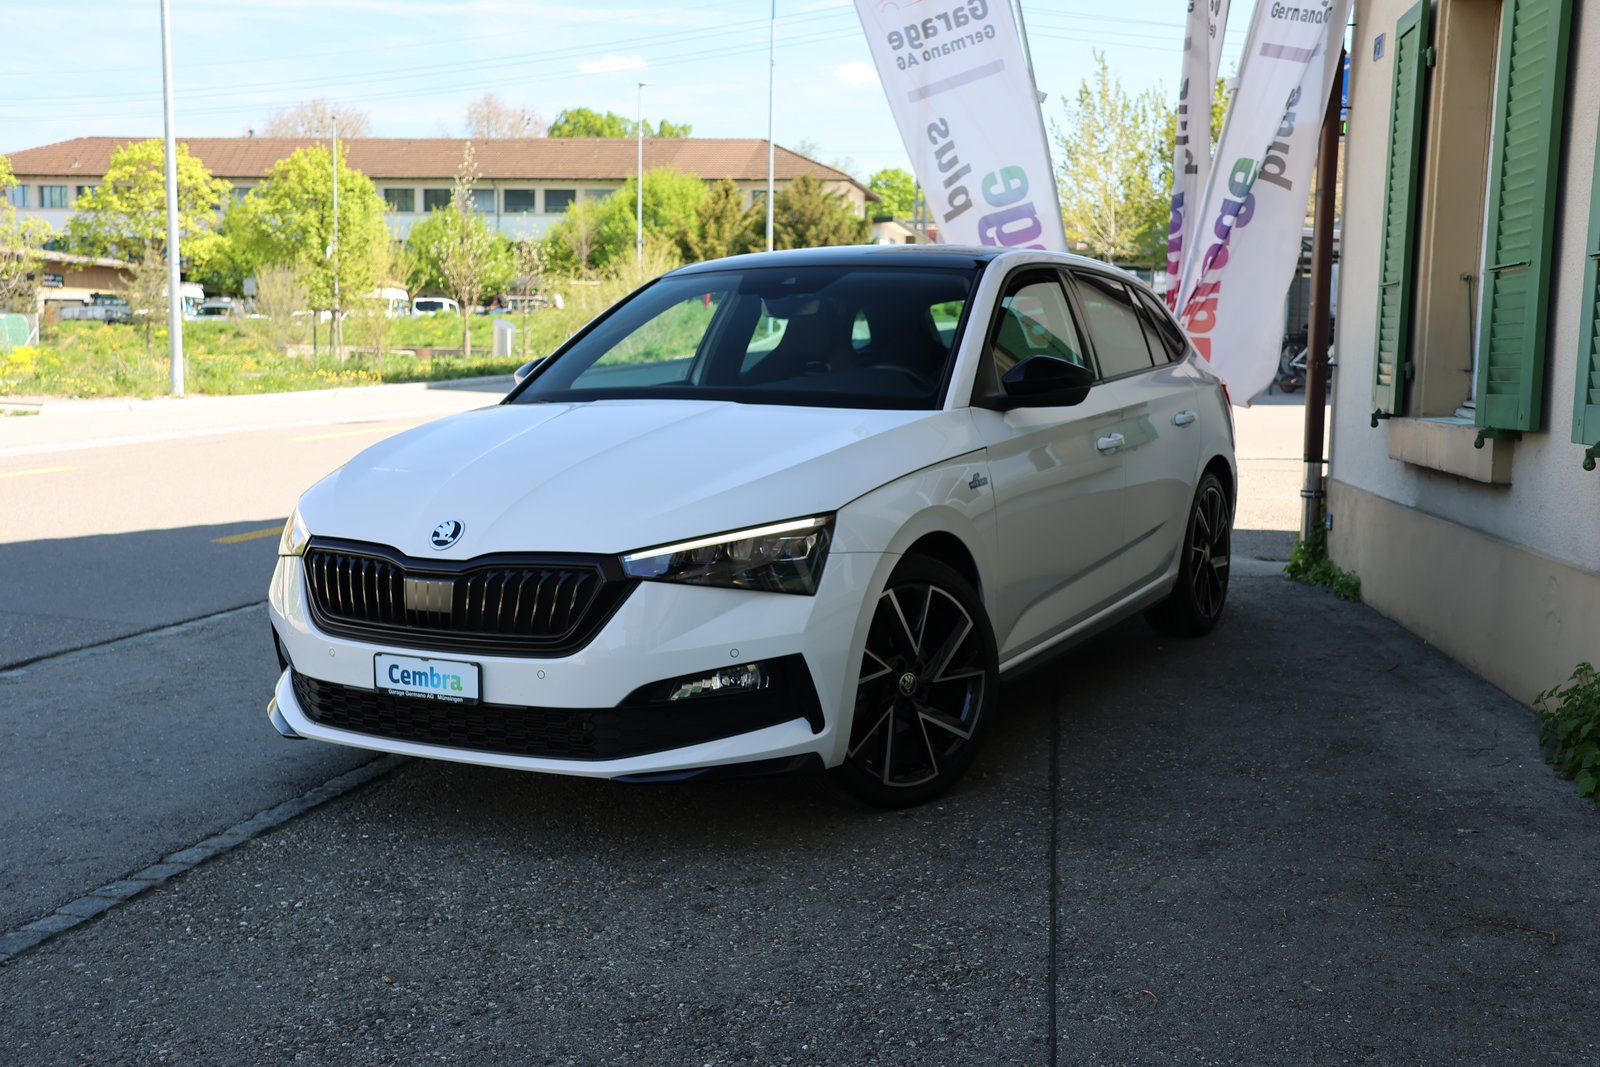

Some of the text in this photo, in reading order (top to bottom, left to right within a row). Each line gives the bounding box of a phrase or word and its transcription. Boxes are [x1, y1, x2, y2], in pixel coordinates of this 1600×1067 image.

[1271, 1, 1323, 25] Germano
[388, 664, 463, 691] Cembra
[388, 688, 405, 697] Garage
